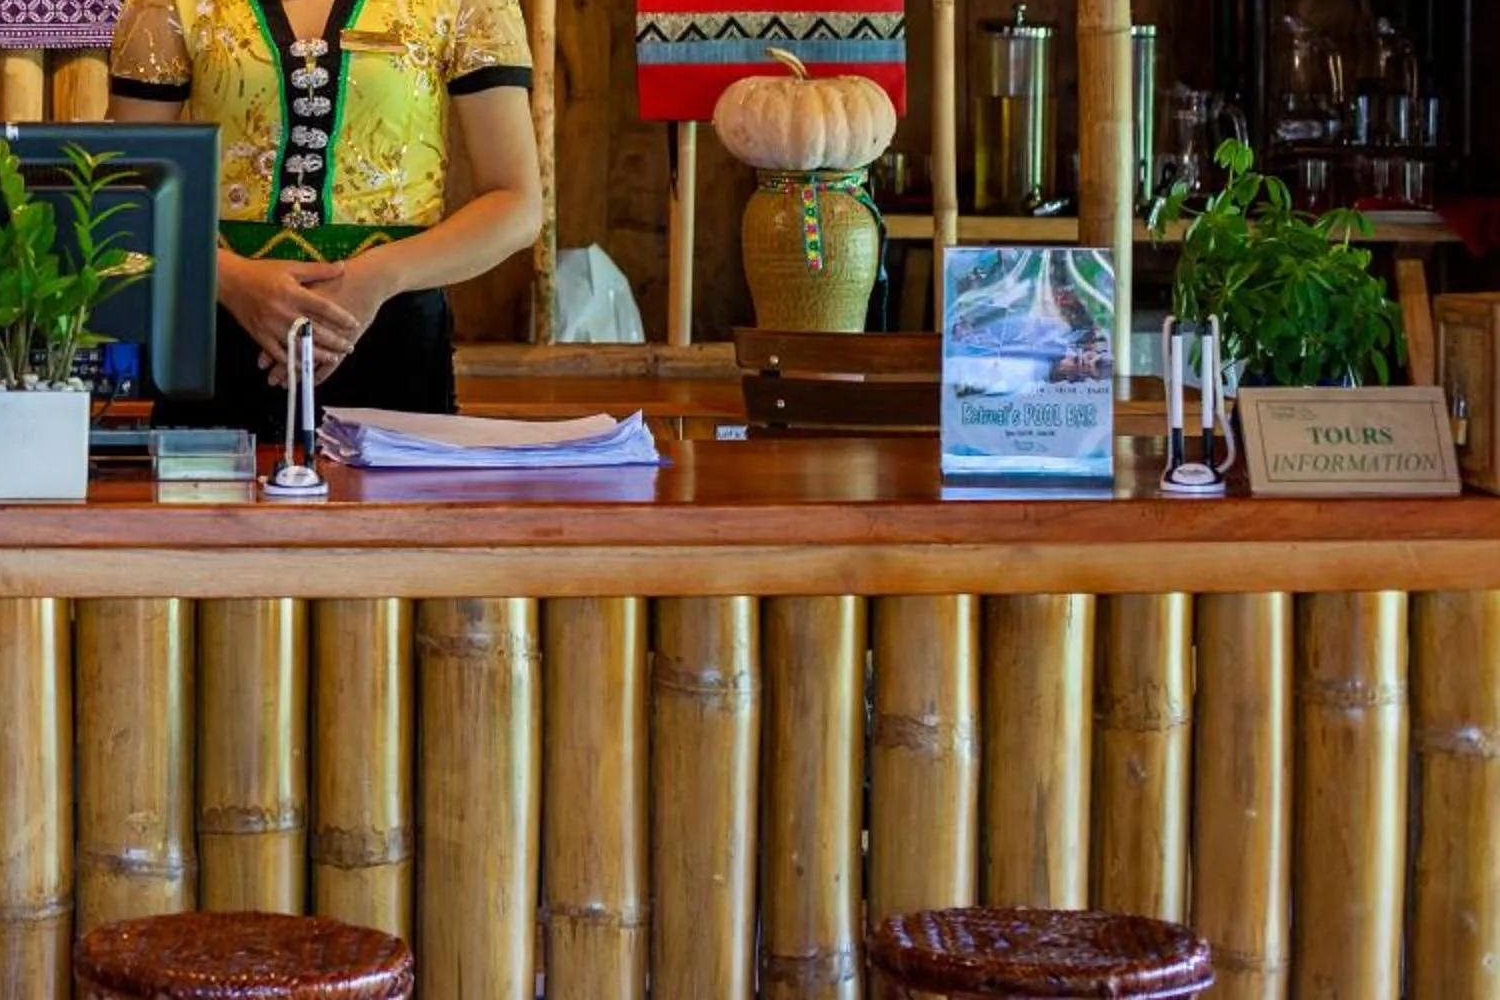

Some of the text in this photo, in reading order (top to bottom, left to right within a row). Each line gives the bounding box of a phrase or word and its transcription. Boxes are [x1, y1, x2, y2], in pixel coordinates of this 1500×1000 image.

[1023, 403, 1062, 428] POOL
[1065, 403, 1097, 428] BAR
[1306, 426, 1394, 444] TOURS
[1272, 452, 1438, 473] INFORMATION
